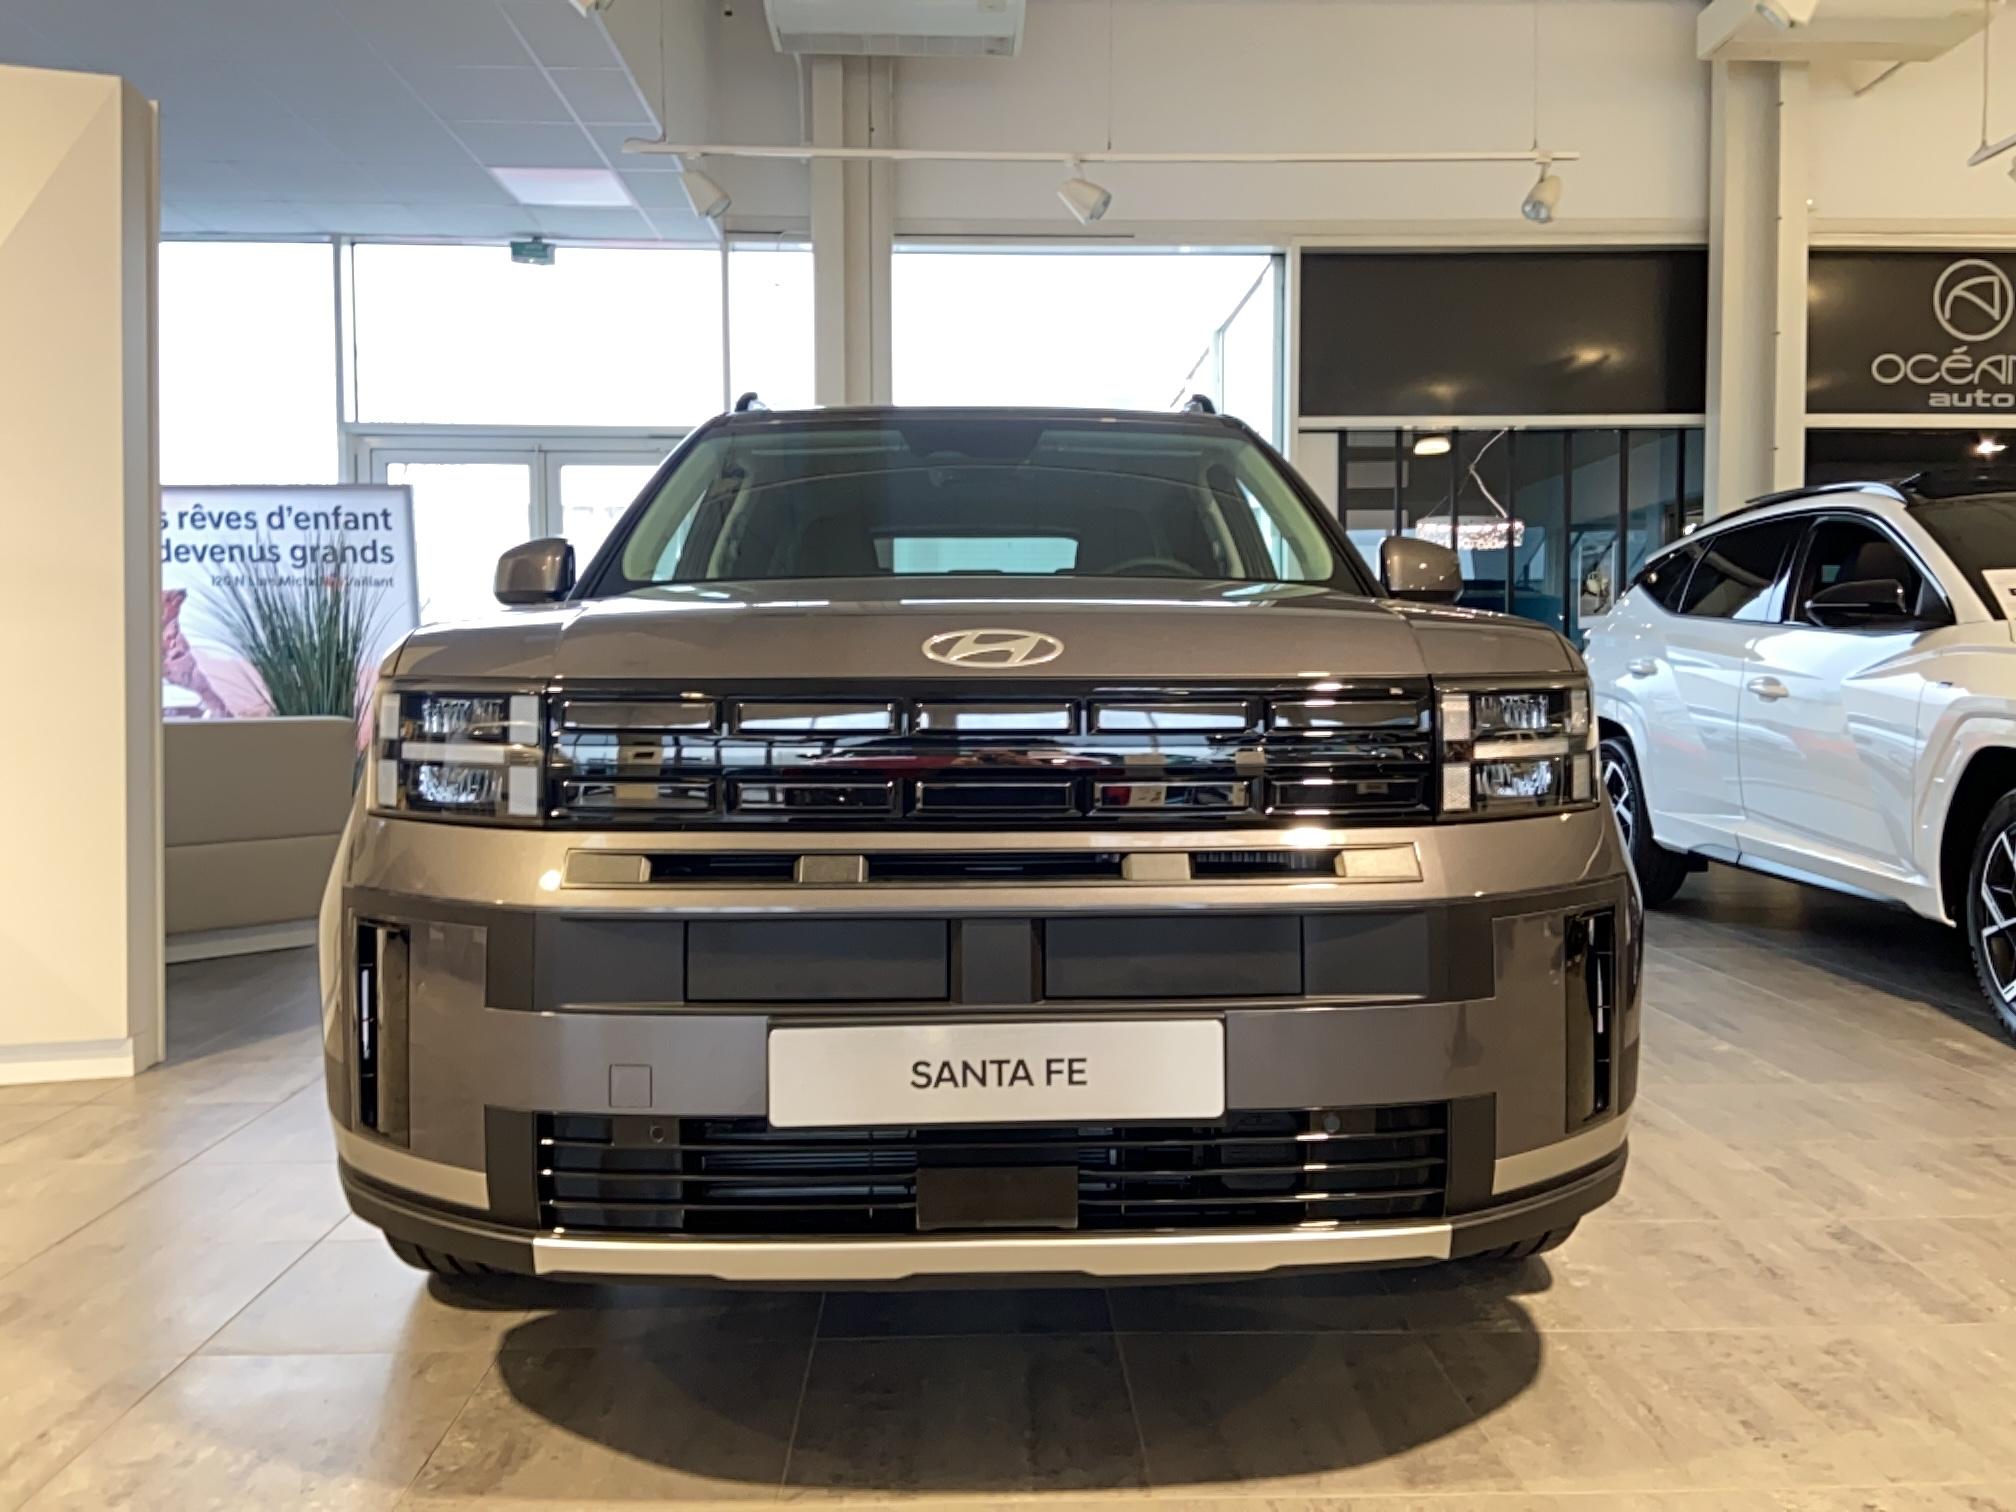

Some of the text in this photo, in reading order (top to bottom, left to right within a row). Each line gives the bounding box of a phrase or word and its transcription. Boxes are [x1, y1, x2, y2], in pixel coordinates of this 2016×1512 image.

[1928, 389, 2015, 408] auto
[178, 504, 257, 530] rêves
[161, 538, 394, 568] devenus grands
[911, 1058, 1088, 1089] SANTA FE
